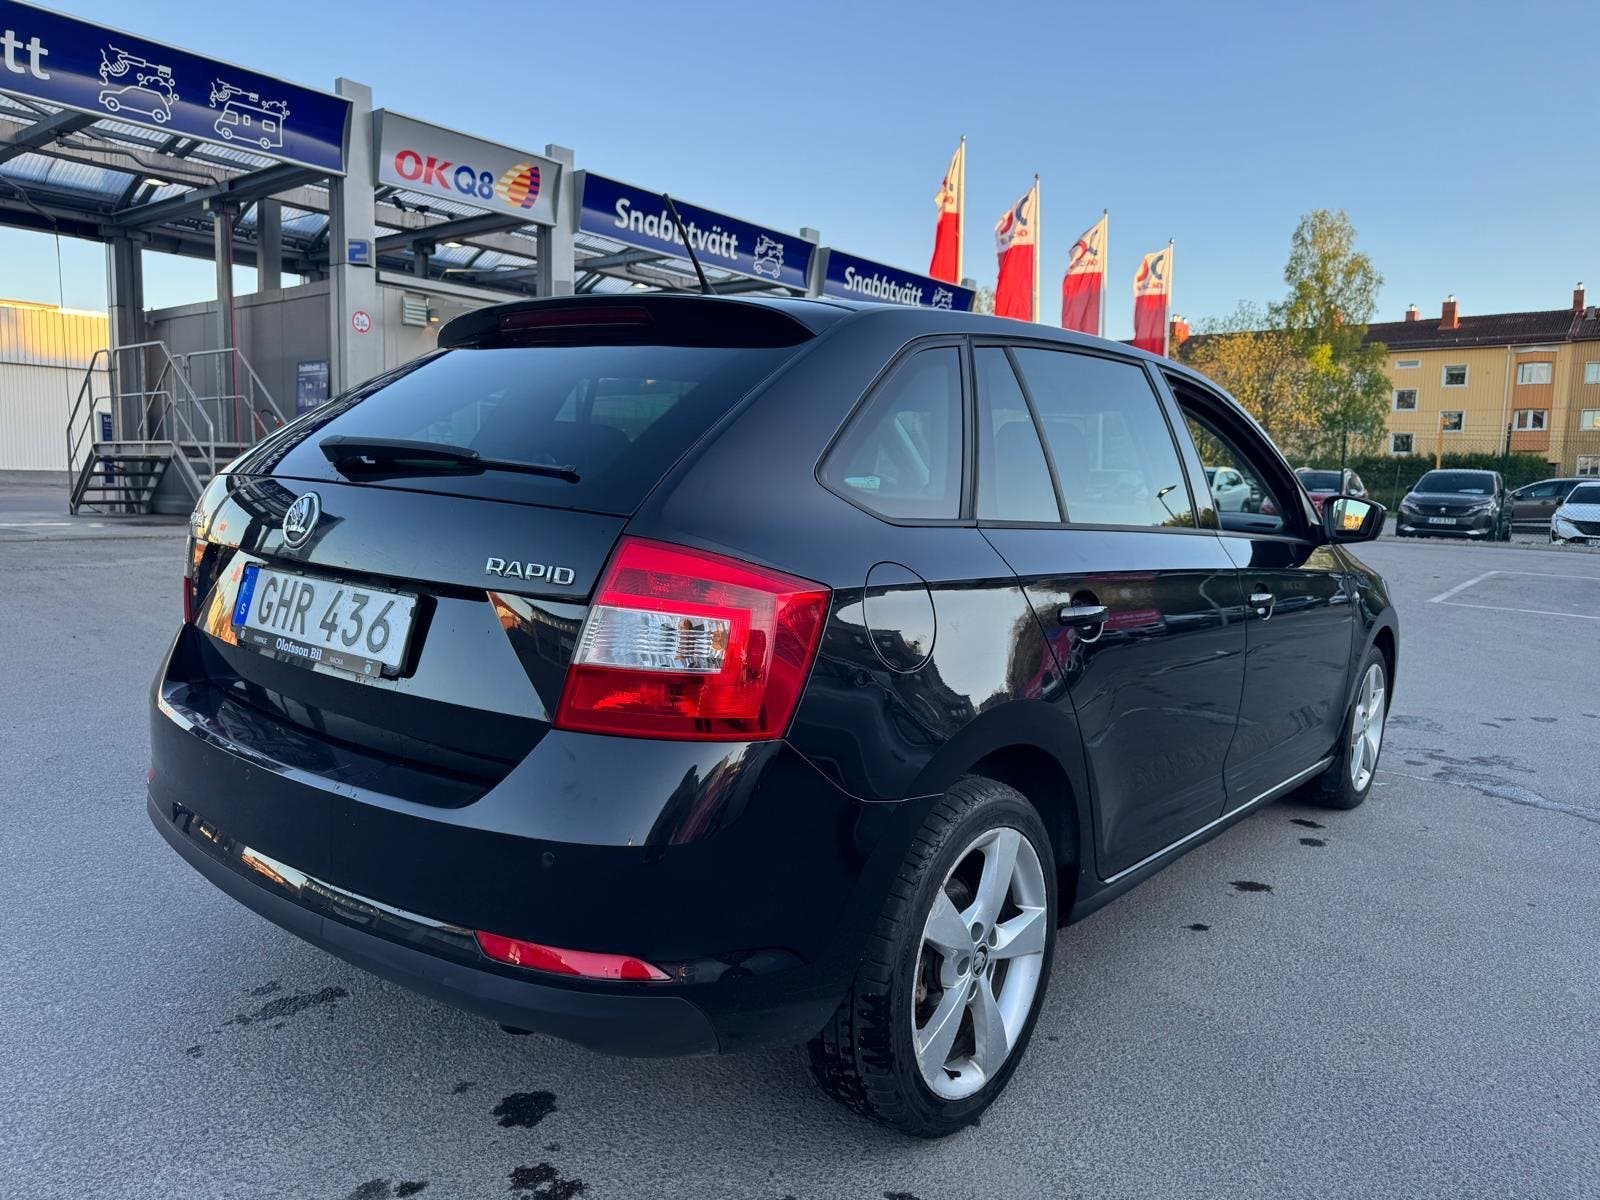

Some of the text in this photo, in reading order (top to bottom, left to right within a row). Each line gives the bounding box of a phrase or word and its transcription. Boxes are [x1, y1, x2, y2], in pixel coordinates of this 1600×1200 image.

[348, 241, 368, 262] 2
[843, 266, 923, 307] Snabbtvätt
[485, 557, 575, 585] RAPID
[239, 602, 247, 615] S
[257, 576, 395, 653] GHR 436
[275, 637, 322, 661] Olofsson Bil
